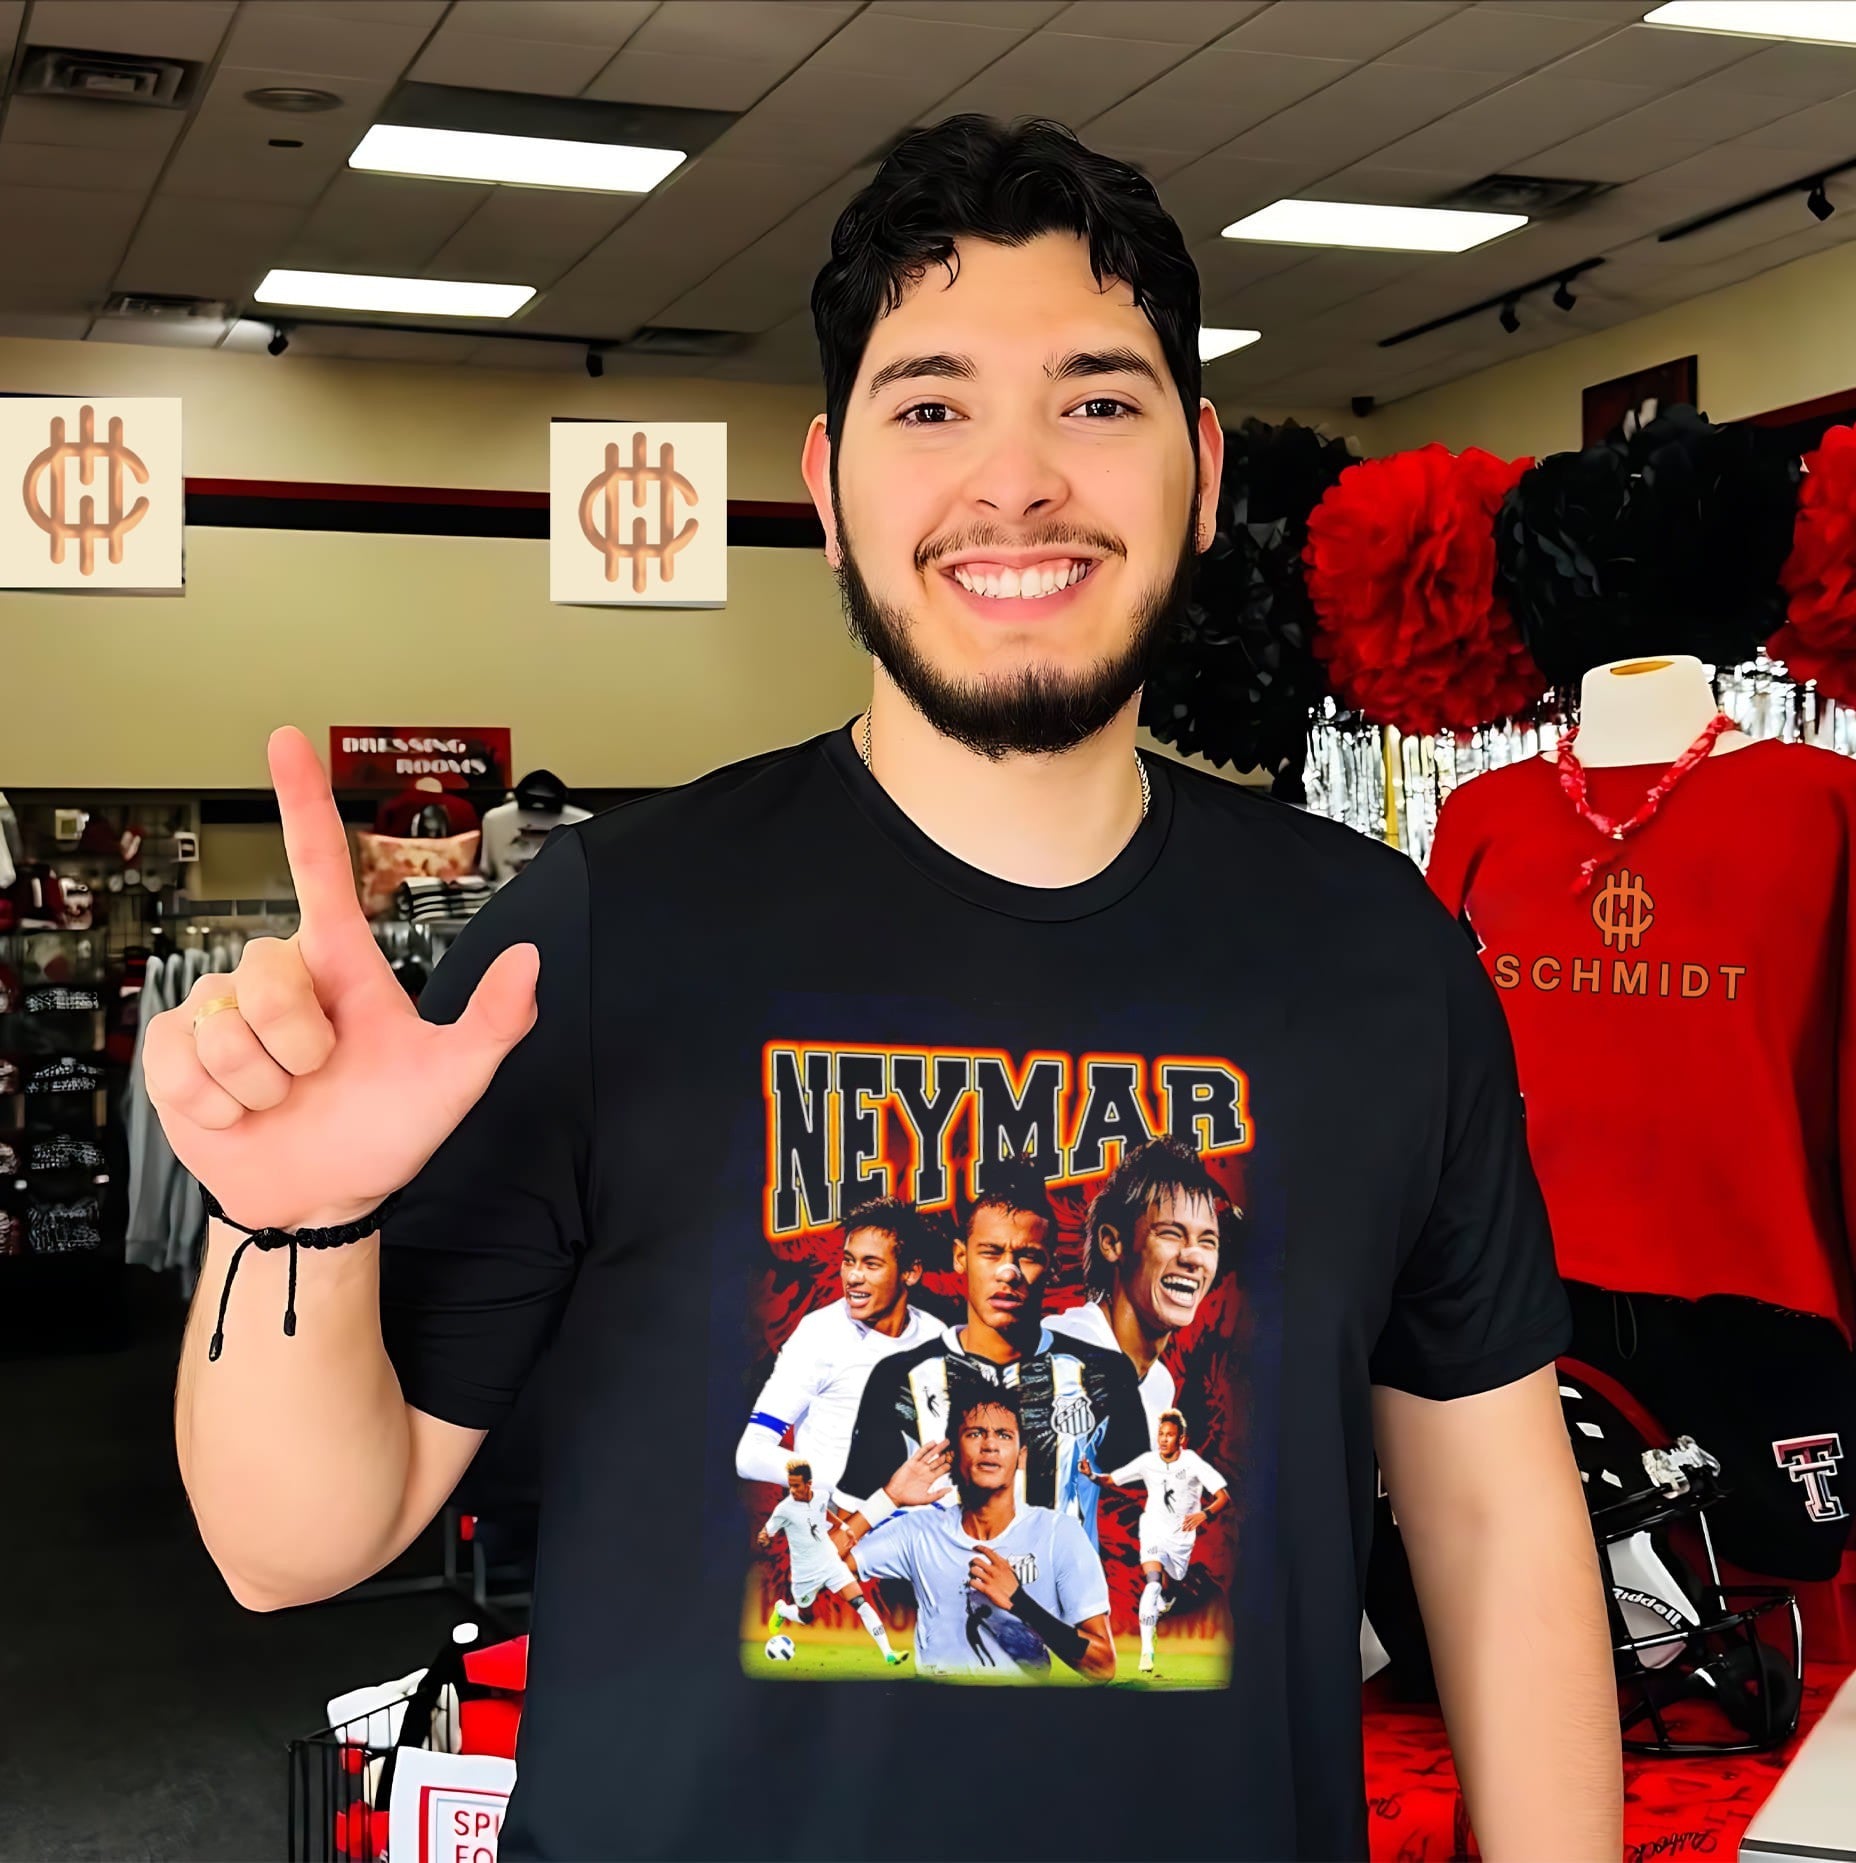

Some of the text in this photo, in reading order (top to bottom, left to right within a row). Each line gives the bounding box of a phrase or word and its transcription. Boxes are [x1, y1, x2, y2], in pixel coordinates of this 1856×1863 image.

[342, 736, 467, 754] DRESSING
[396, 758, 487, 775] ROOMS
[1494, 954, 1747, 1001] SCHMIDT
[766, 1046, 1252, 1236] NEYMAR
